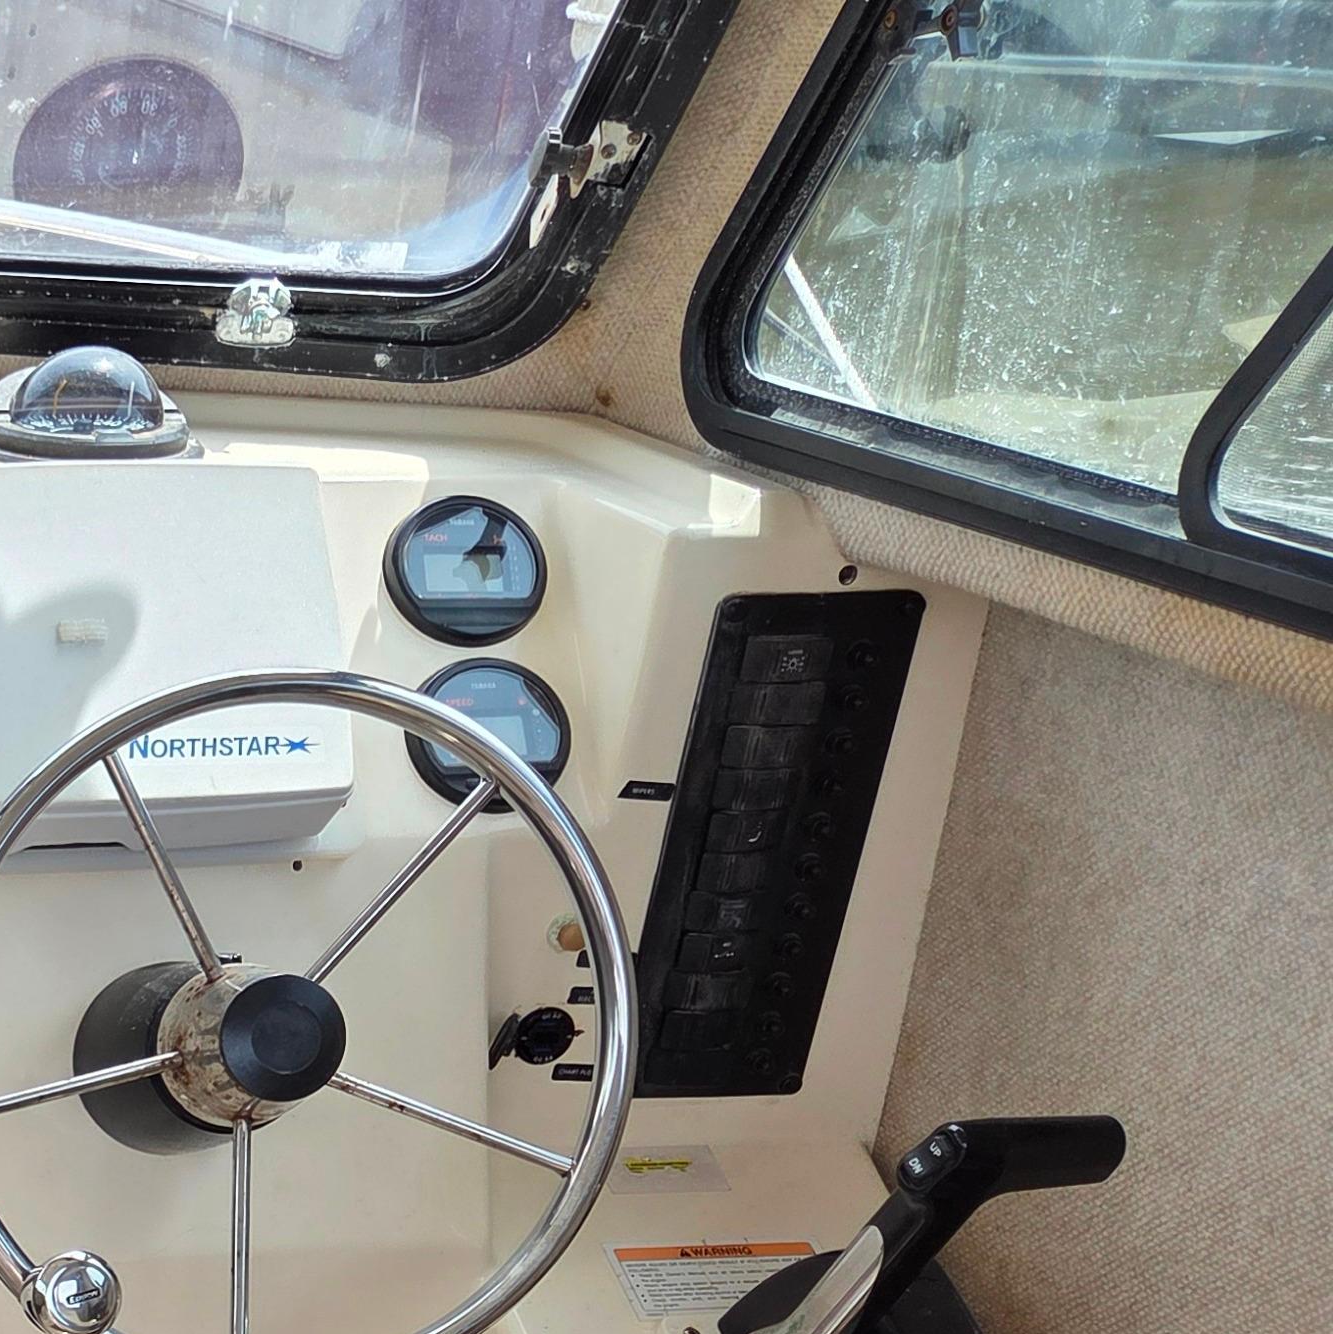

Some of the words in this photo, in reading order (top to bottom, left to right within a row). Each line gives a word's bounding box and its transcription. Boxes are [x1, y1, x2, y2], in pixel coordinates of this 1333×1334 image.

[425, 533, 448, 542] TACH
[446, 698, 474, 707] SPEED
[129, 735, 281, 759] NORTHSTAR
[929, 1141, 942, 1157] UP
[908, 1157, 924, 1175] DN
[691, 1246, 753, 1257] WARNING
